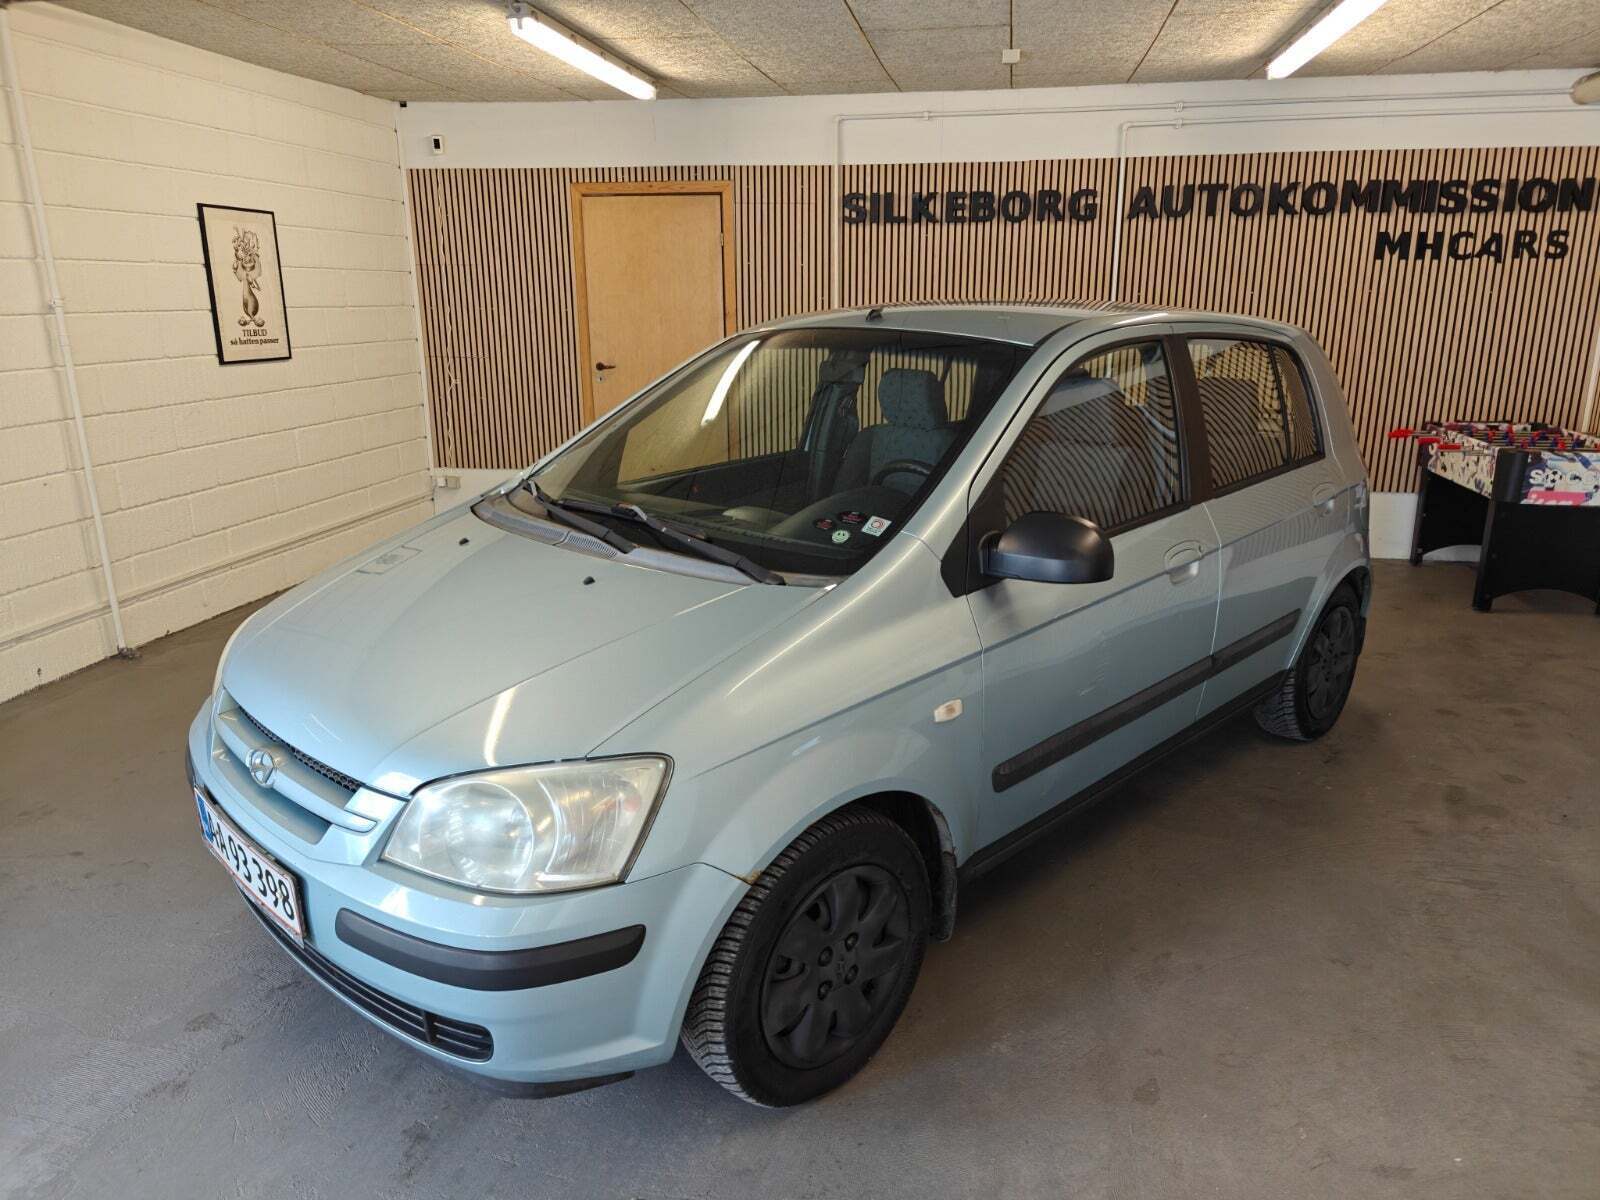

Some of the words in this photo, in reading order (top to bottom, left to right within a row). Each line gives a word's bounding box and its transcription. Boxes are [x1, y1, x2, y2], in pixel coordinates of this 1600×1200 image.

[842, 189, 1098, 224] SILKEBORG
[1127, 178, 1596, 219] AUTOKOMMISSION
[1375, 230, 1570, 262] MHCARS
[239, 337, 259, 345] hatten
[243, 329, 267, 337] TILBUD
[228, 835, 252, 883] 93
[252, 857, 295, 920] 398
